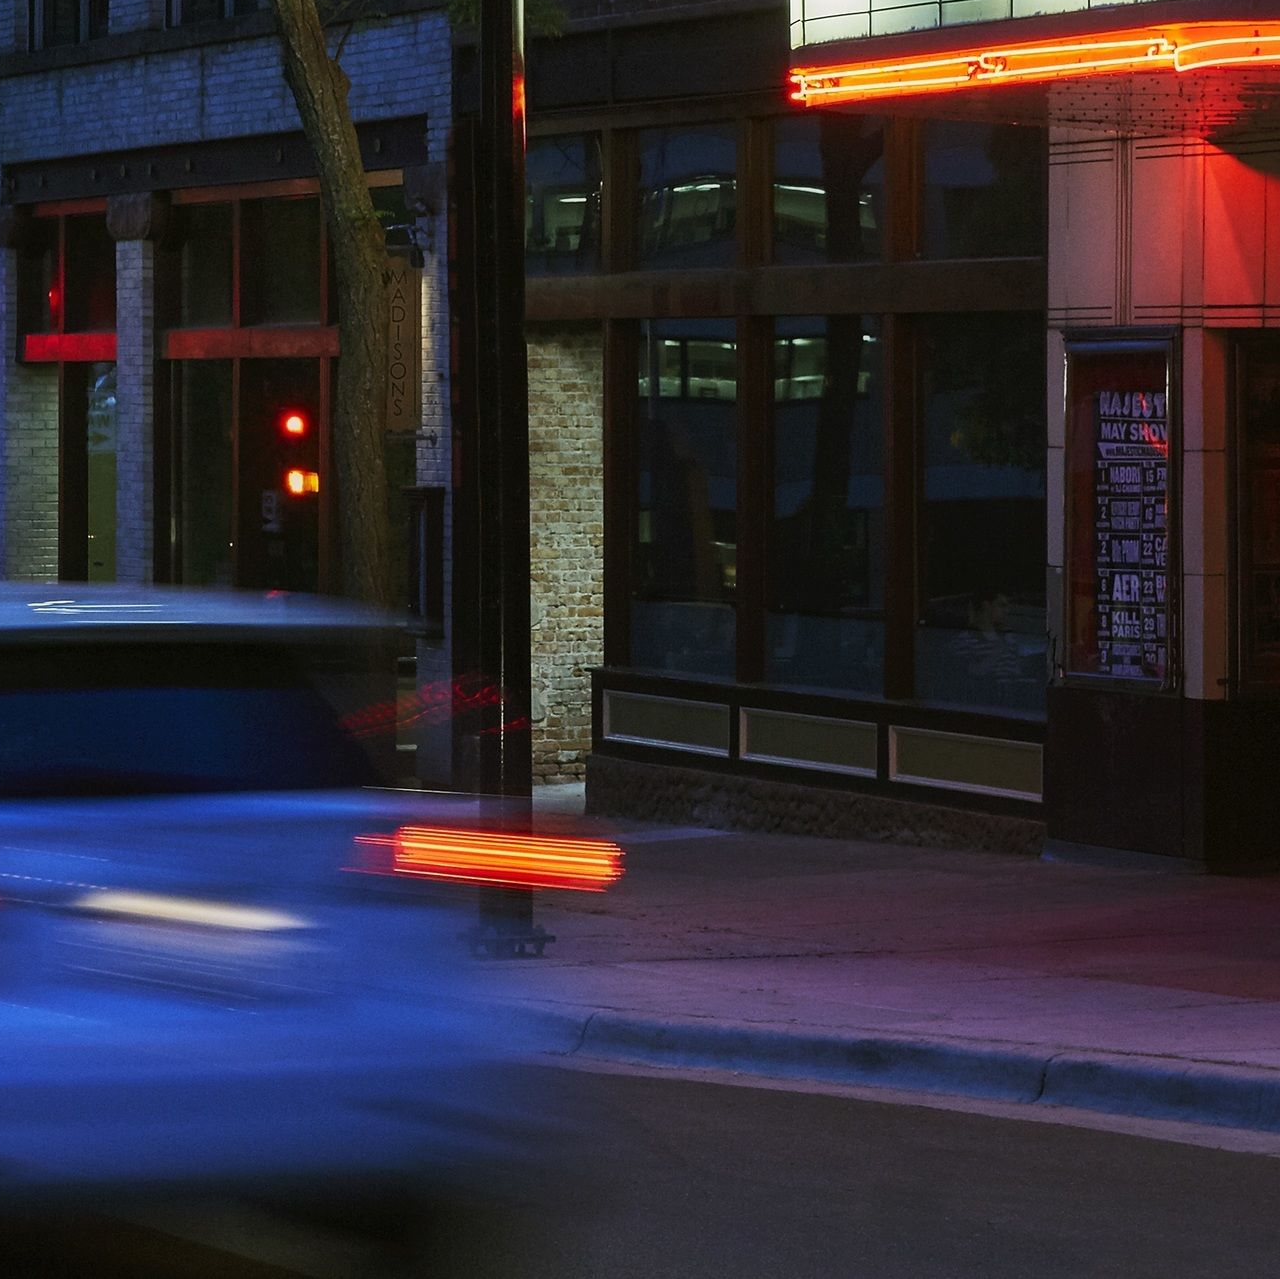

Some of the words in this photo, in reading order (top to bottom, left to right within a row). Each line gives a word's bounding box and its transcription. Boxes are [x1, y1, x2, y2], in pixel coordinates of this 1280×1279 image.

[389, 270, 407, 417] MADISONS
[1101, 422, 1127, 440] MAY
[1112, 574, 1140, 602] AER
[1111, 611, 1140, 625] KILL
[1111, 625, 1140, 639] PARIS
